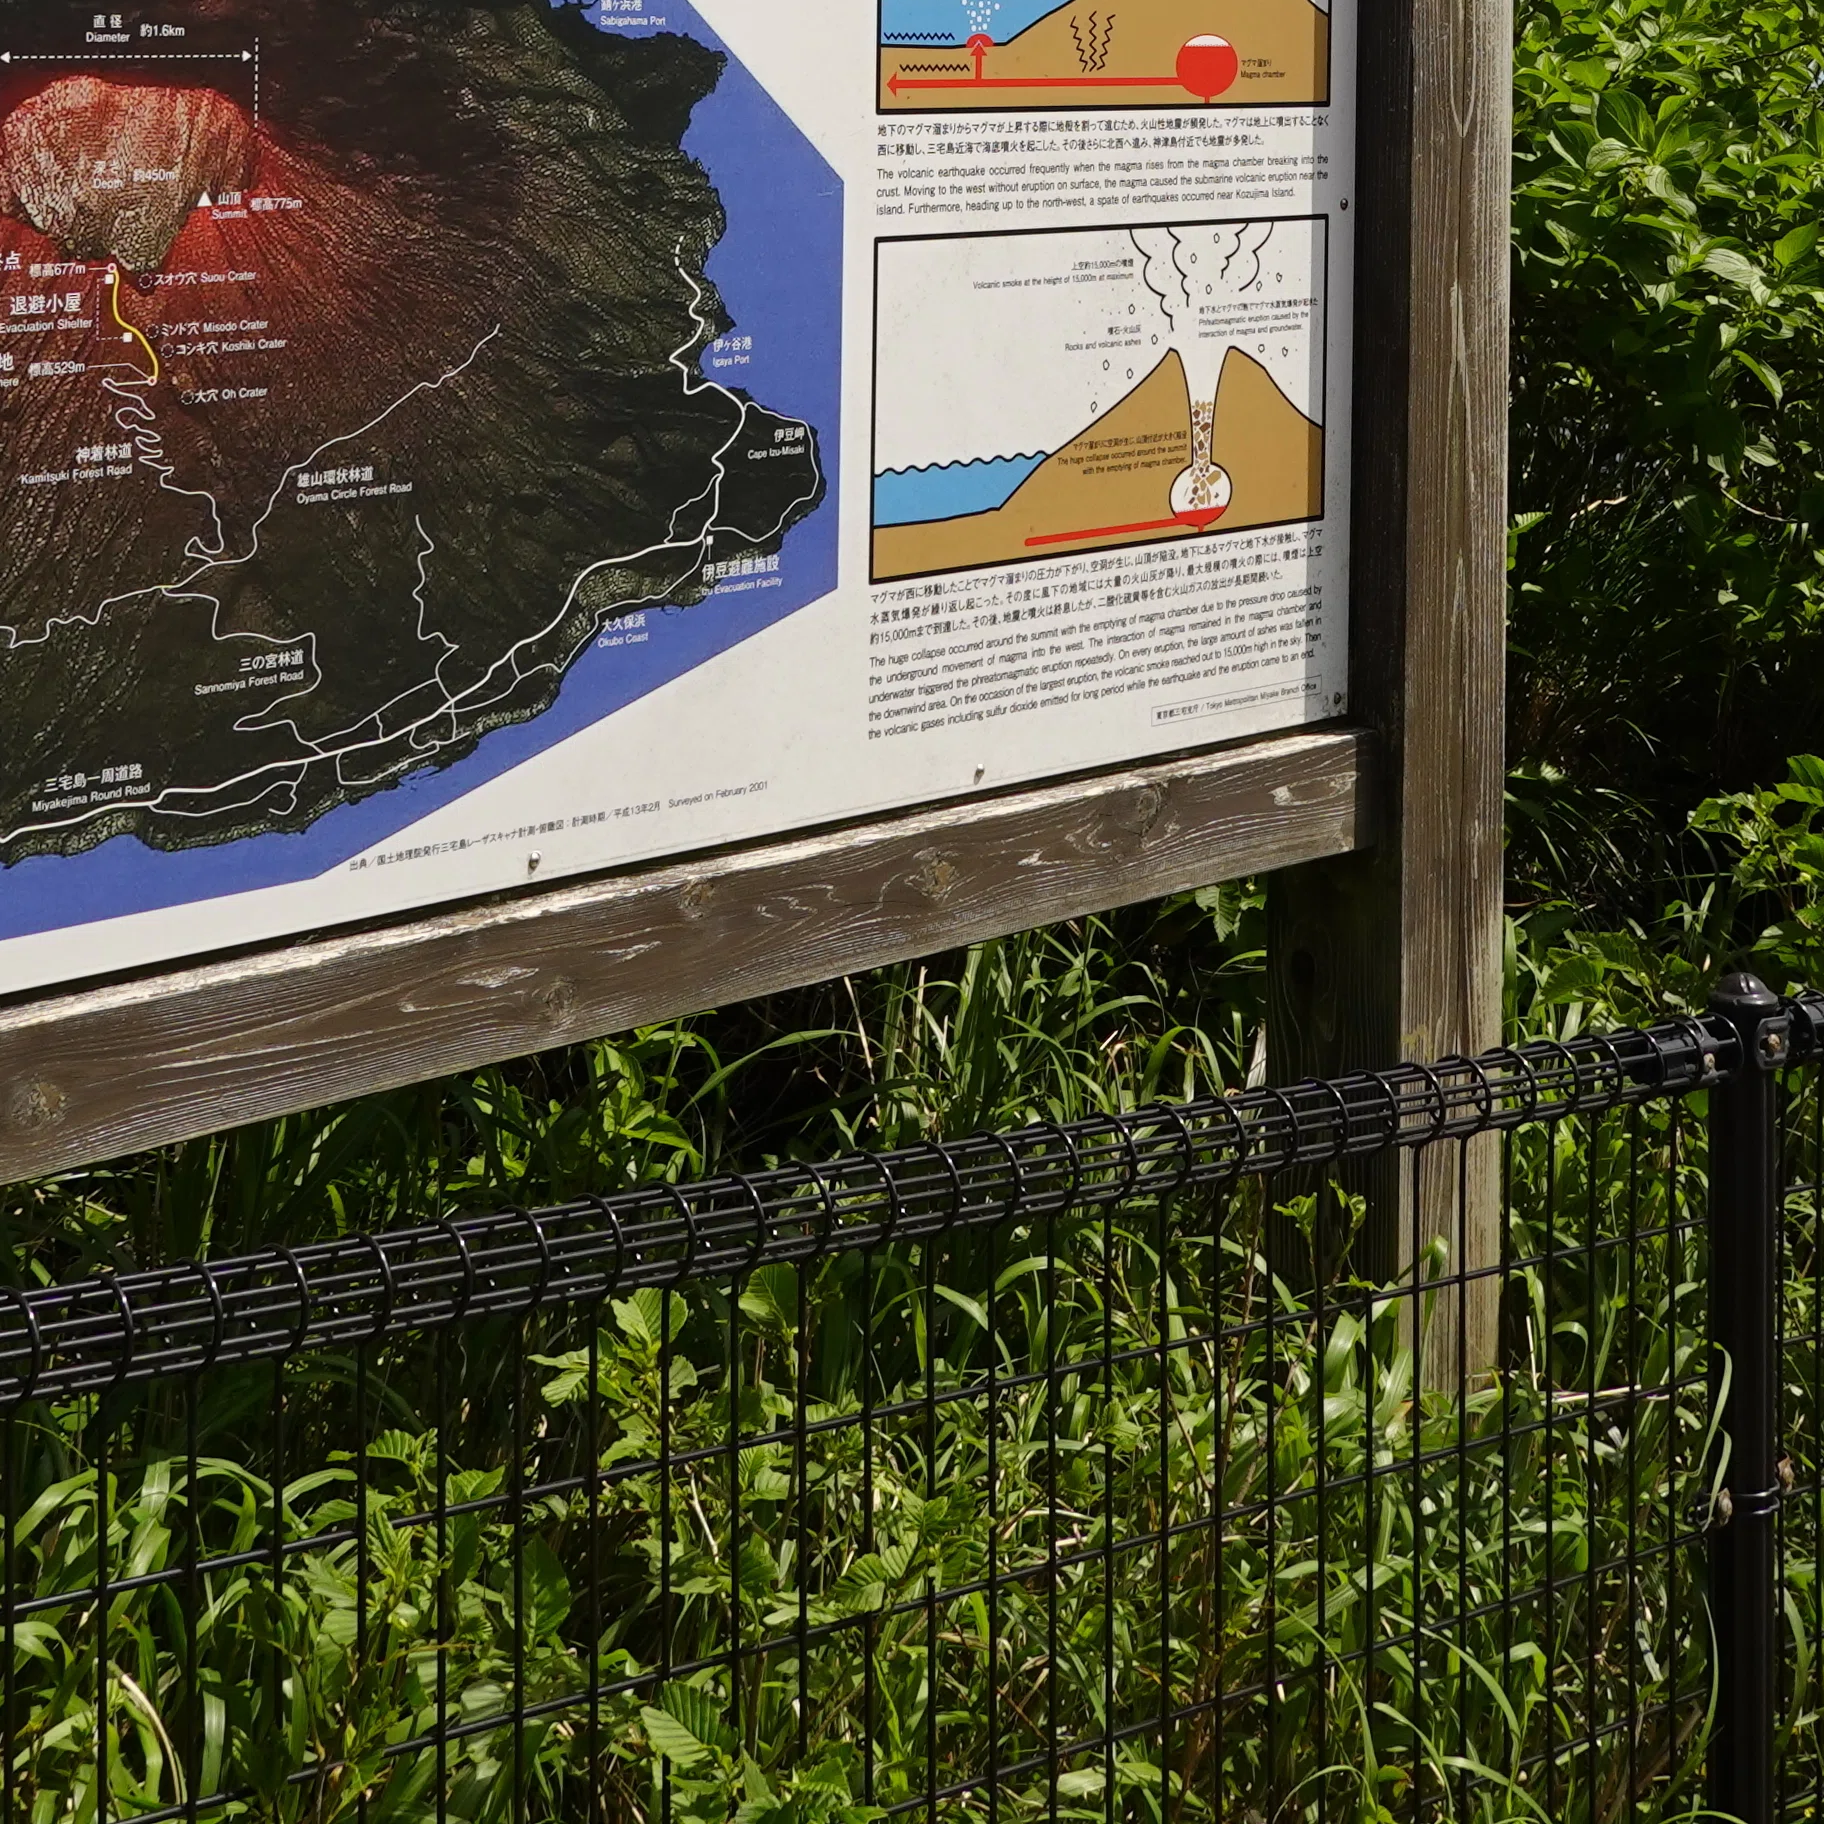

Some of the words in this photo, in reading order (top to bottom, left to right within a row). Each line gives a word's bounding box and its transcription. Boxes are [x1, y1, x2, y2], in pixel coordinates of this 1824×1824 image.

[93, 14, 123, 28] 直径
[600, 15, 648, 27] Sabigahama
[649, 16, 666, 26] Port
[85, 31, 130, 43] Diameter
[140, 24, 185, 37] 約1.6km
[1241, 71, 1260, 79] Magma
[876, 168, 893, 179] The
[897, 167, 934, 178] volcanic
[938, 165, 985, 178] earthquake
[989, 164, 1026, 175] occurred
[1029, 163, 1070, 174] frequently
[1073, 162, 1094, 172] when
[1098, 162, 1110, 171] the
[1114, 162, 1142, 172] magma
[1146, 160, 1164, 169] rises
[1167, 159, 1184, 169] from
[1187, 158, 1199, 168] the
[1202, 158, 1229, 169] magma
[1232, 156, 1264, 166] chamber
[1267, 155, 1298, 166] breaking
[1301, 154, 1314, 164] into
[1317, 154, 1328, 164] the
[93, 178, 123, 189] Depth
[217, 191, 242, 205] 山頂
[250, 197, 303, 211] 標高775m
[212, 209, 248, 220] Summit
[29, 262, 86, 278] 標高677m
[200, 272, 225, 283] Suou
[227, 270, 256, 281] Crater
[10, 292, 82, 315] 退避小屋
[57, 318, 93, 330] Shelter
[203, 321, 237, 333] Misodo
[239, 319, 269, 331] Crater
[176, 341, 219, 356] コシキ穴
[222, 339, 255, 352] Koshiki
[258, 338, 287, 350] Crater
[734, 355, 750, 365] Port
[28, 361, 86, 377] 標高529m
[195, 389, 219, 403] 大穴
[222, 388, 236, 399] Oh
[239, 387, 268, 399] Crater
[747, 449, 767, 460] Cape
[769, 444, 804, 457] Izu-Misaki
[21, 469, 70, 484] Kamitsuki
[72, 466, 104, 479] Forest
[106, 463, 133, 476] Road
[296, 465, 374, 488] 雄山環状林道
[296, 492, 329, 505] Oyama
[330, 488, 357, 501] Circle
[359, 484, 388, 497] Forest
[389, 481, 413, 494] Road
[701, 586, 714, 596] Izu
[714, 582, 755, 595] Evacuation
[756, 577, 783, 589] Facility
[601, 613, 646, 633] 大久保浜
[598, 636, 624, 648] Okubo
[626, 632, 649, 644] Coast
[238, 648, 304, 672] 三の宮林道
[194, 680, 246, 696] Sannomiya
[248, 674, 277, 687] Forest
[280, 669, 304, 683] Road
[44, 763, 143, 793] 三宅島一周道路
[32, 794, 88, 812] Miyakejima
[90, 787, 122, 802] Round
[125, 782, 151, 796] Road
[668, 793, 703, 808] Surveyed
[704, 793, 714, 802] on
[715, 785, 747, 799] February
[749, 780, 768, 793] 2001
